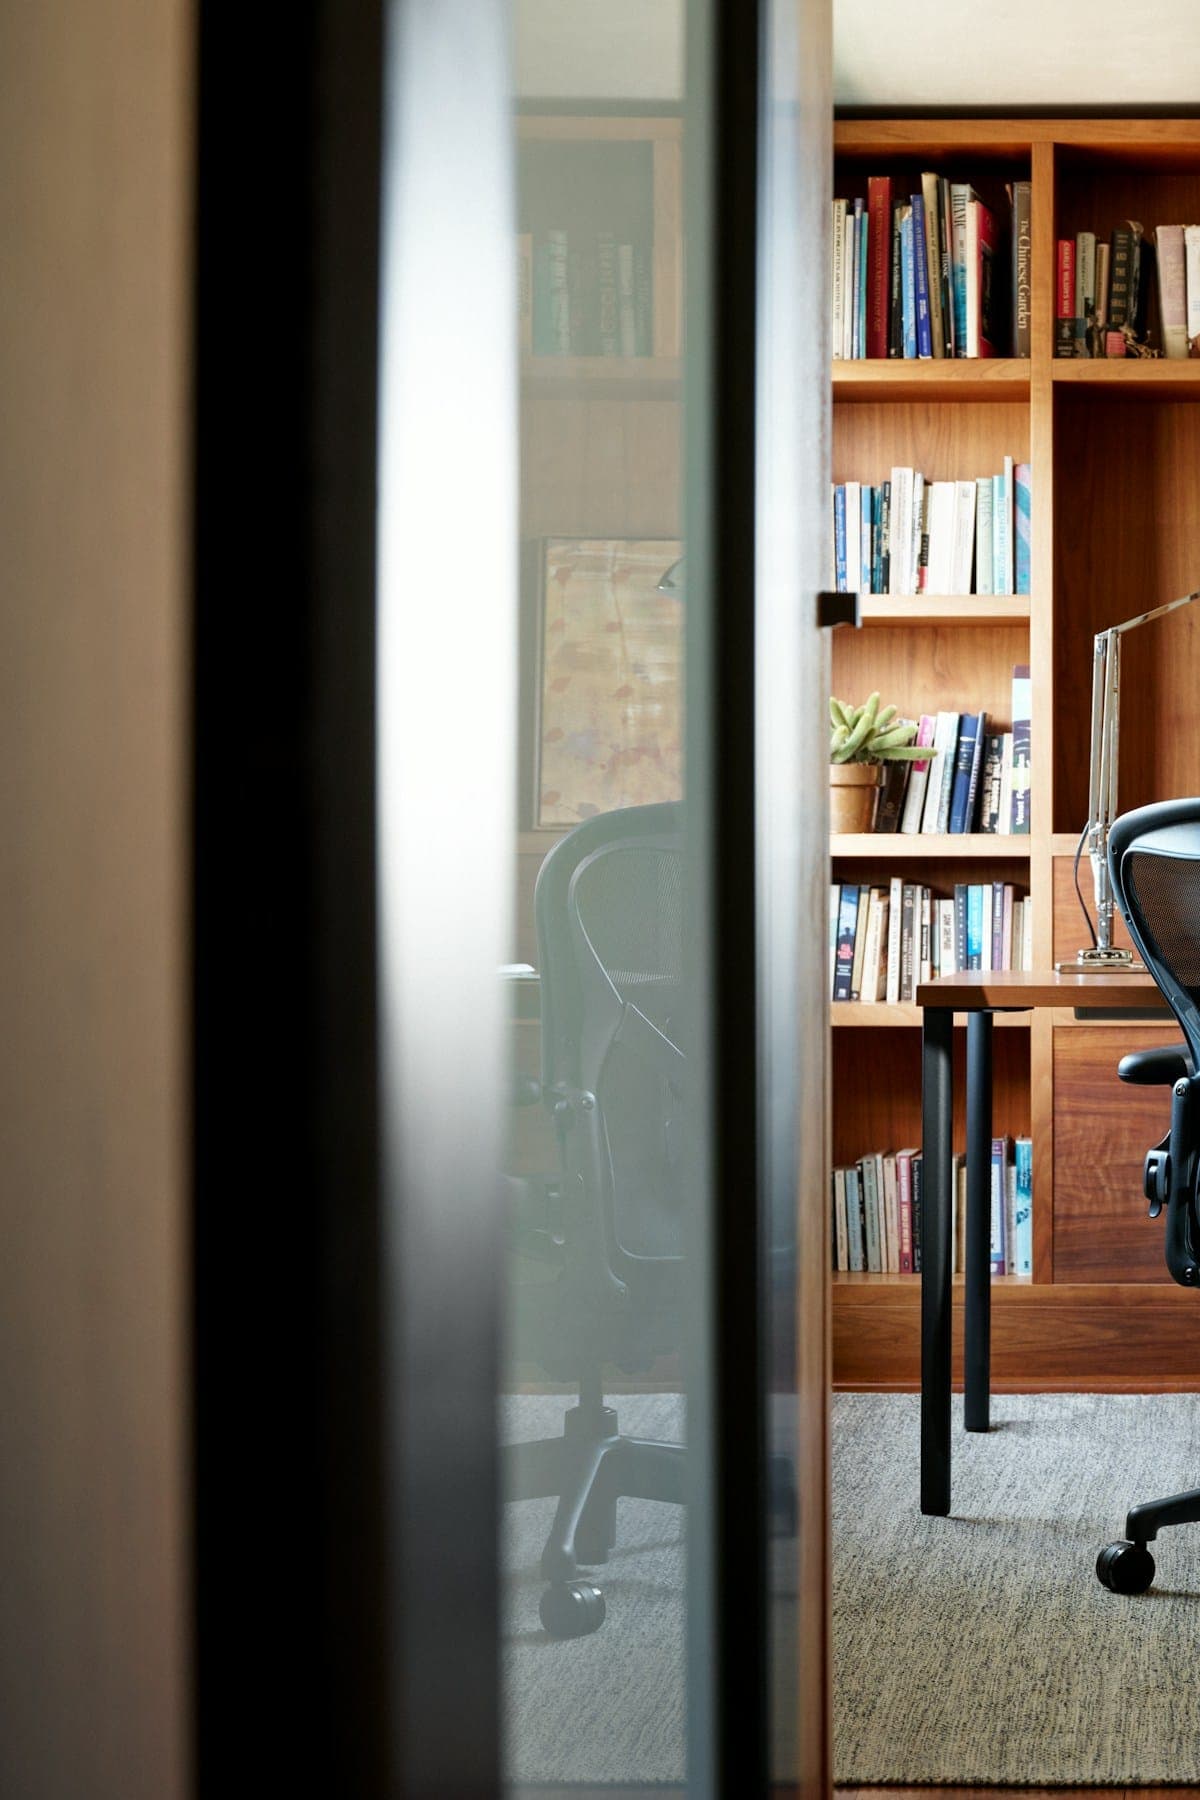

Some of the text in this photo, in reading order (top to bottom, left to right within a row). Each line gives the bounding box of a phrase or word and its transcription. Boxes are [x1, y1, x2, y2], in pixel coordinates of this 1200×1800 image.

[1017, 220, 1031, 329] The Chinese Garden
